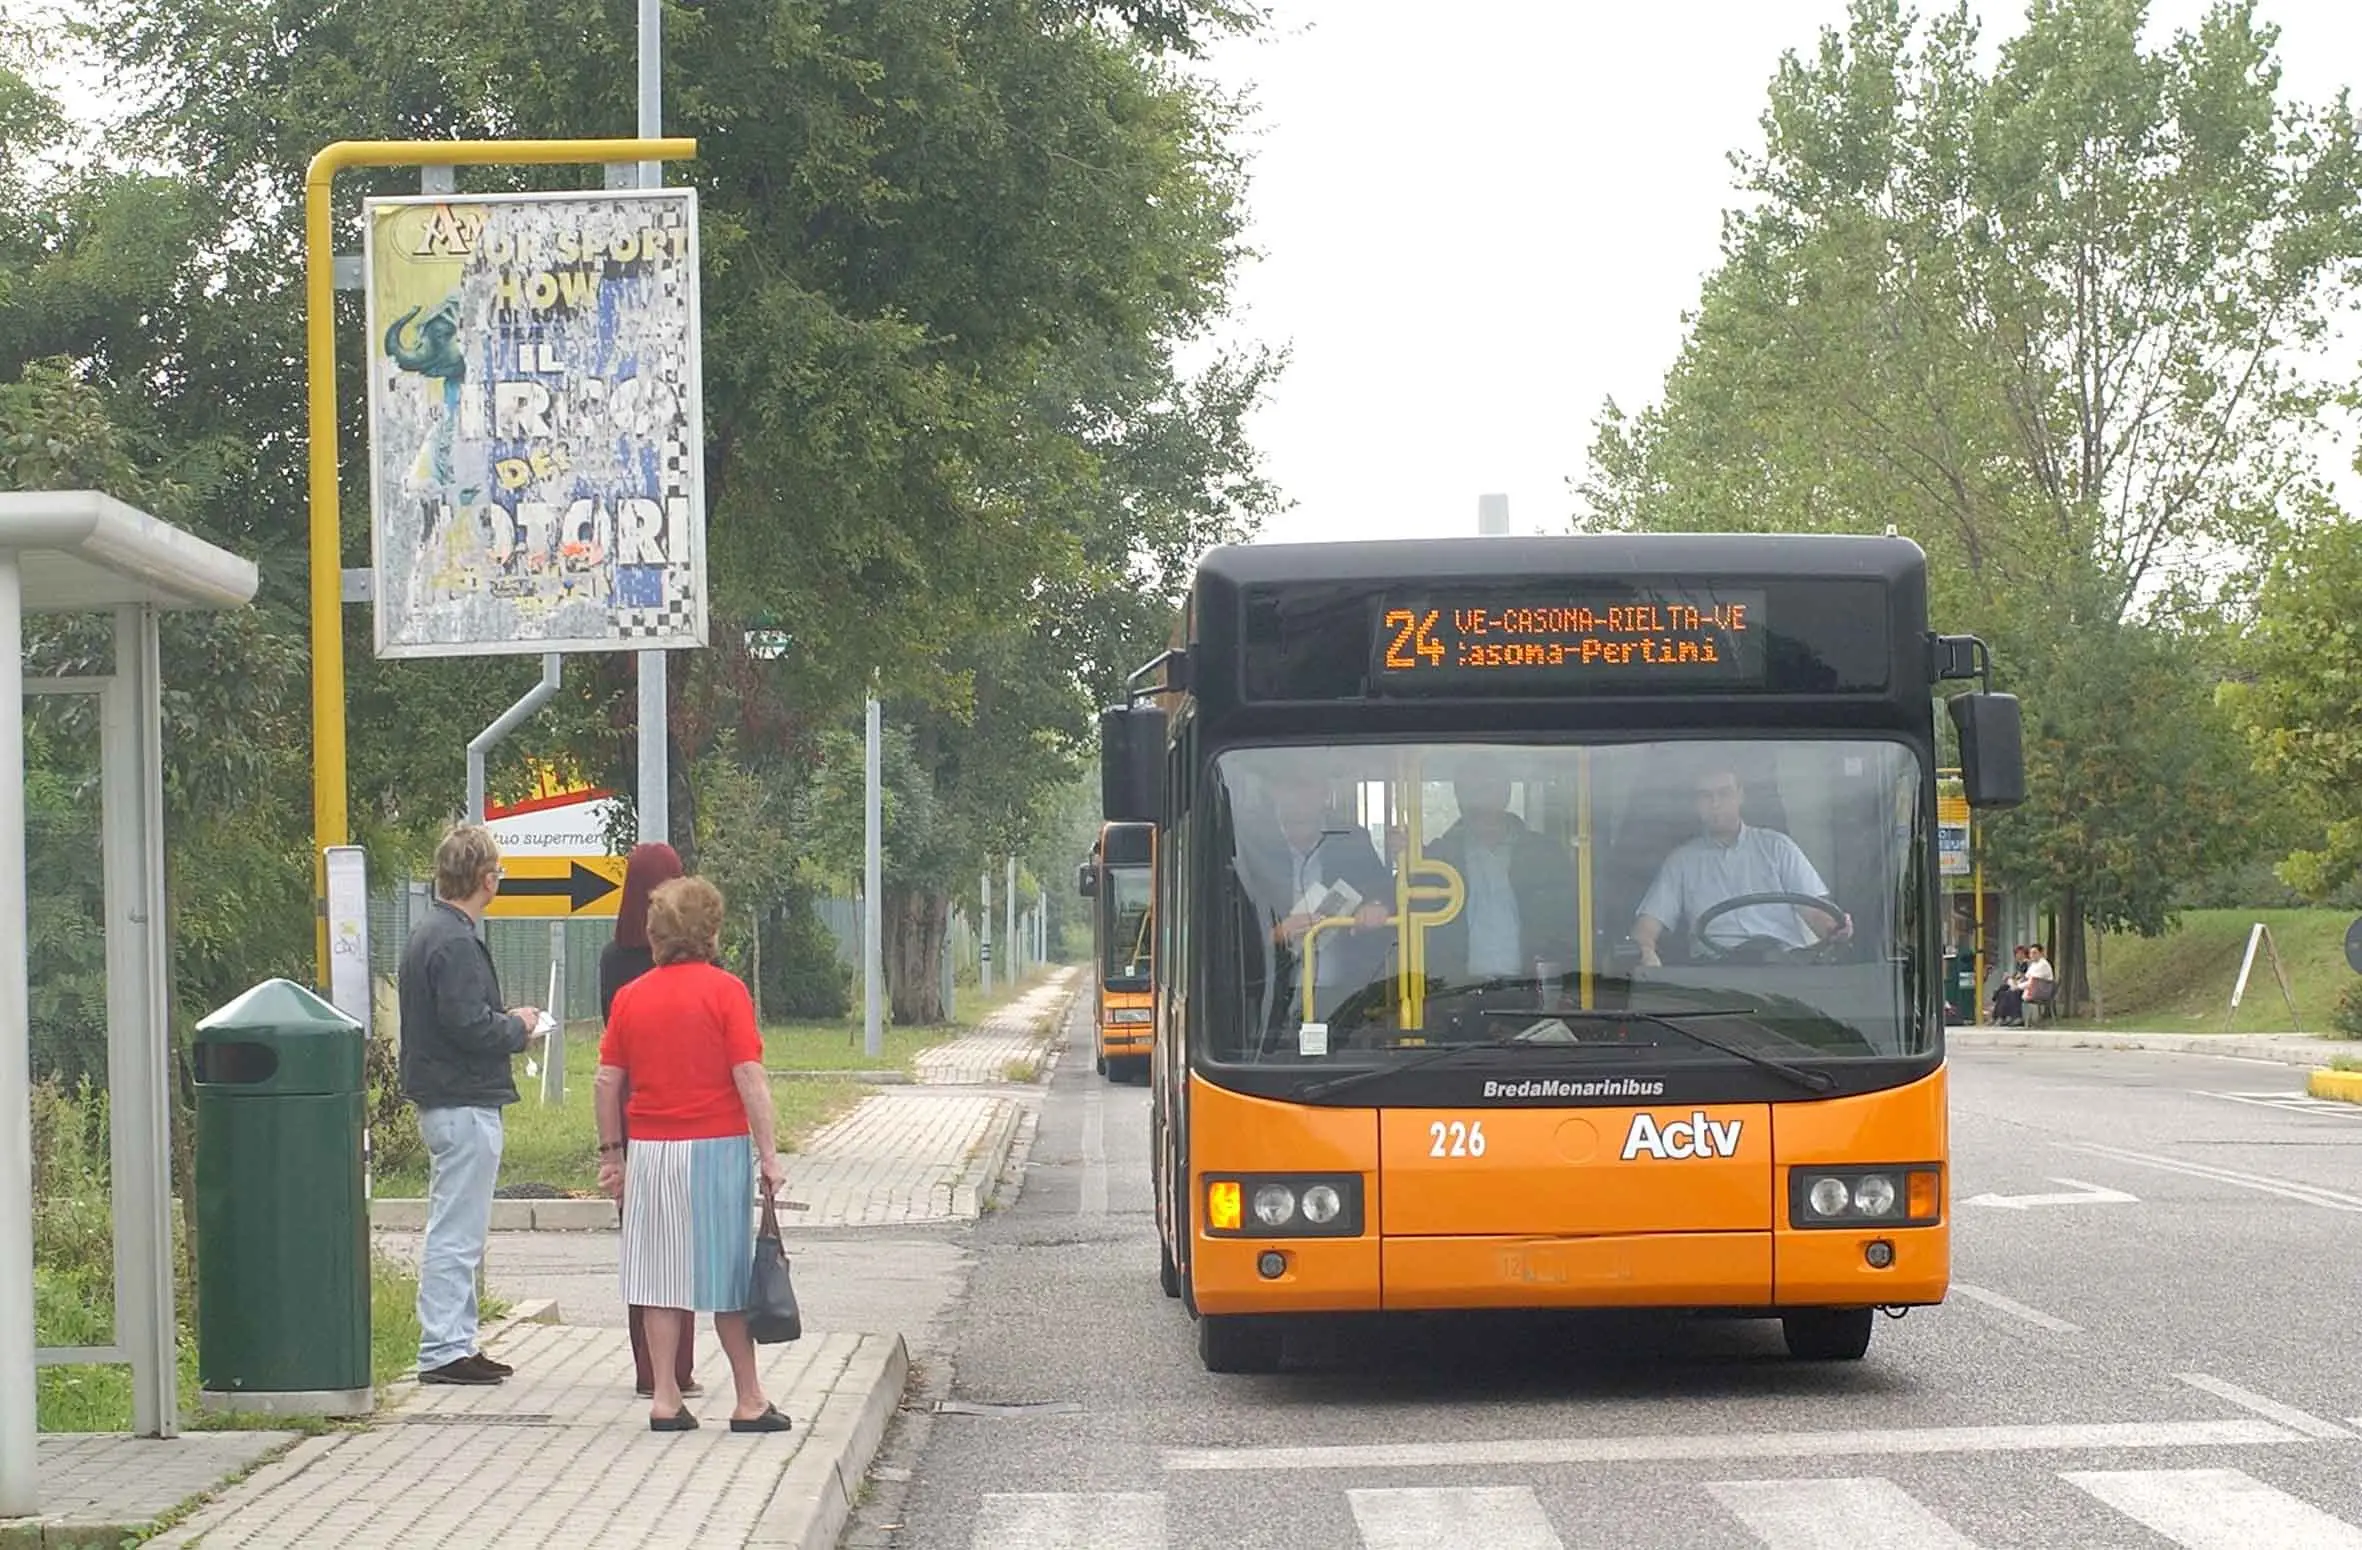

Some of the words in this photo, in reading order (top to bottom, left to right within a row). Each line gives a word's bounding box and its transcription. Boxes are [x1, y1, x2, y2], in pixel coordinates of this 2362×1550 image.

[517, 343, 564, 373] IL
[438, 497, 689, 566] OTORI
[1385, 609, 1445, 668] 24
[1459, 637, 1719, 667] asona-Pertini
[523, 832, 610, 848] supermer
[1484, 1080, 1664, 1097] BredaMenarinibus
[1429, 1120, 1486, 1158] 226
[1620, 1111, 1744, 1160] Actv
